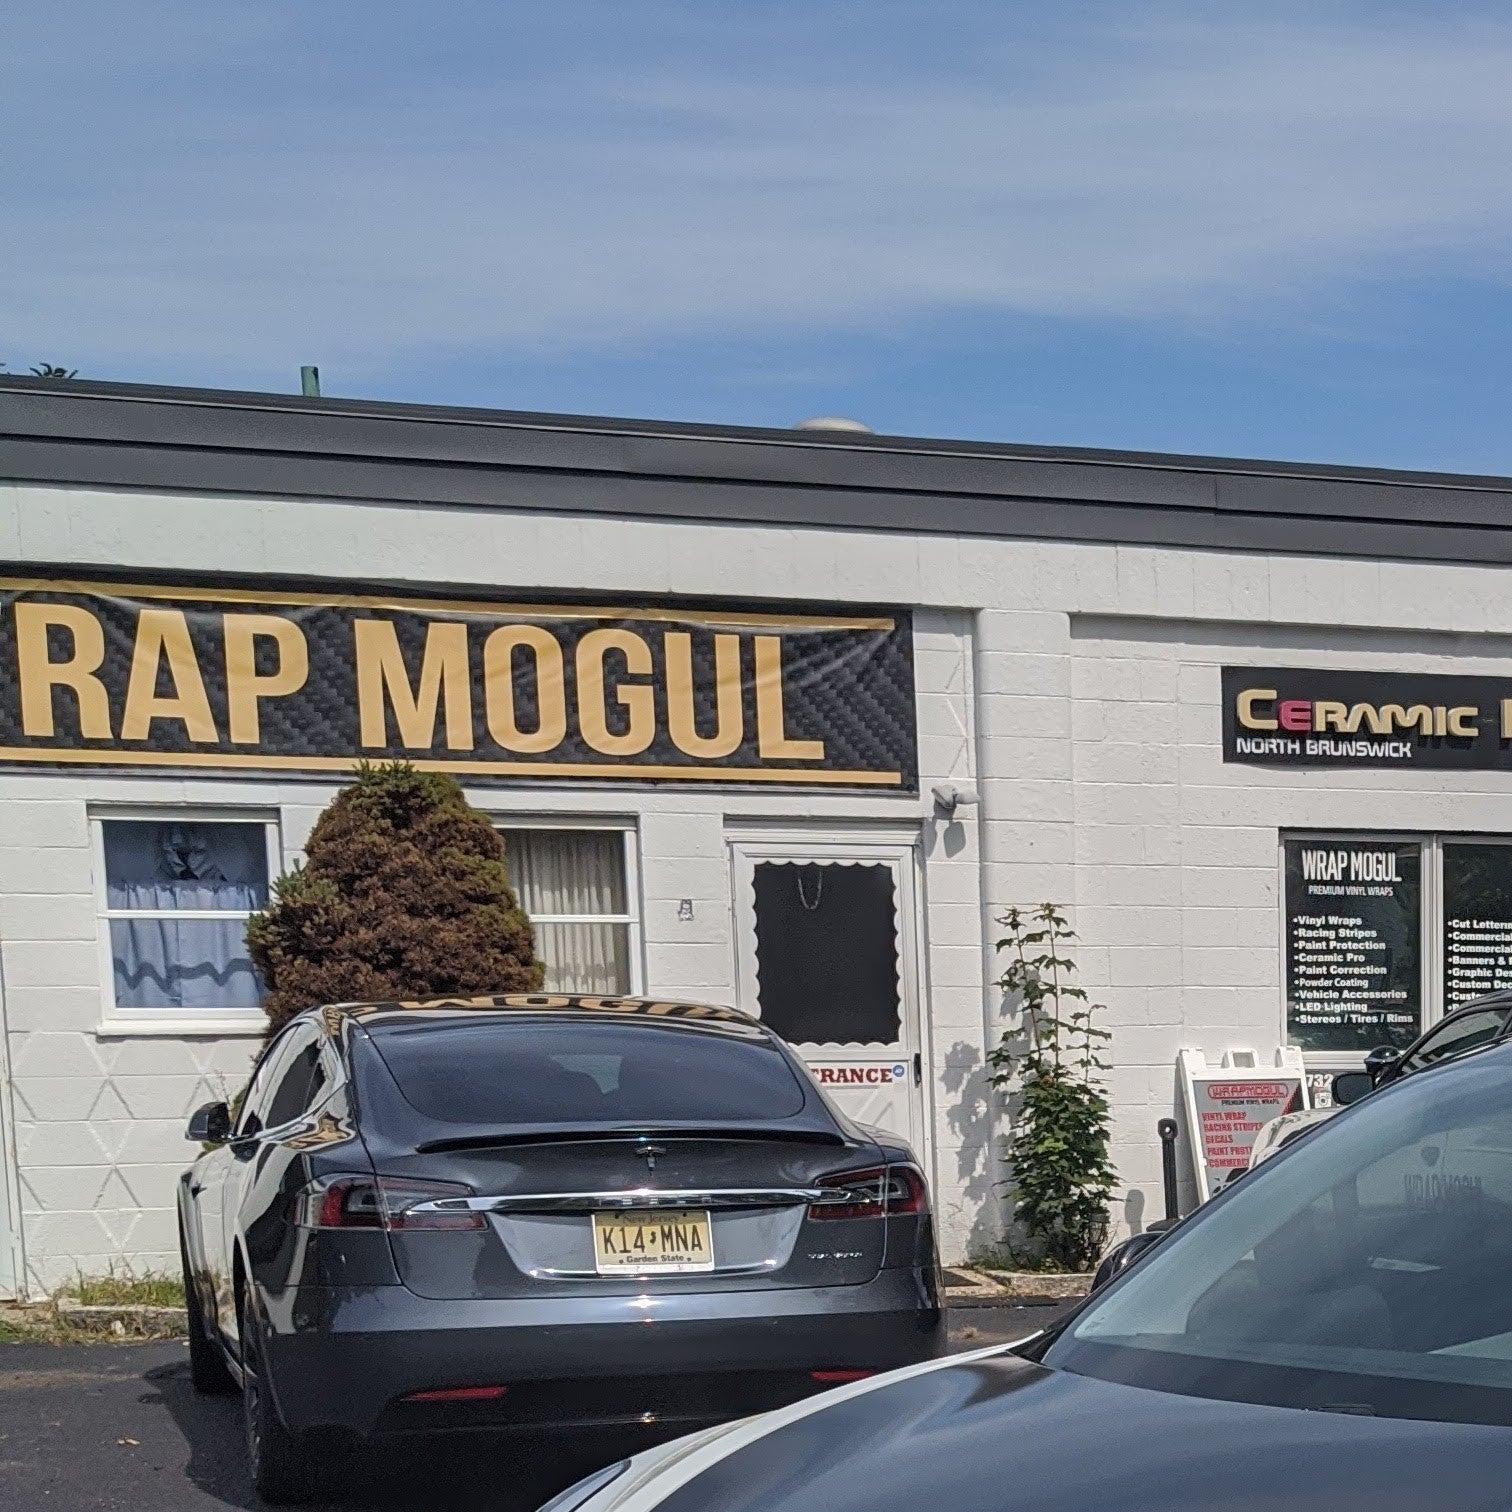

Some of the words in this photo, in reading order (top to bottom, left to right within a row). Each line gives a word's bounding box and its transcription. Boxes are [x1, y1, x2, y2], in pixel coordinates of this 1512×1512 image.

[15, 601, 309, 744] RAP
[353, 619, 825, 760] MOGUL
[1236, 688, 1478, 737] CERAMIC
[1236, 737, 1300, 755] NORTH
[1305, 738, 1411, 758] BRUNSWICK
[1302, 849, 1347, 881] WRAP
[1350, 851, 1402, 882] MOGUL
[1308, 885, 1344, 895] PREMIUM
[1346, 886, 1366, 896] VINYL
[1368, 886, 1393, 897] WRAPS
[1298, 916, 1325, 927] Vinyl
[1328, 916, 1362, 927] Wraps
[1452, 920, 1470, 929] Cut
[1298, 928, 1336, 939] Racing
[1338, 928, 1377, 939] Stripes
[1298, 941, 1327, 950] Paint
[1329, 941, 1386, 950] Protection
[1299, 953, 1344, 962] Ceramic
[1346, 953, 1365, 962] Pro
[1452, 956, 1495, 965] Banners
[1497, 957, 1507, 965] &
[1299, 965, 1328, 975] Paint
[1330, 965, 1387, 975] Correction
[1452, 968, 1493, 979] Graphic
[1300, 978, 1332, 987] Powder
[1334, 978, 1369, 988] Coating
[1452, 980, 1491, 989] Custom
[1299, 990, 1340, 999] Vehicle
[1342, 990, 1408, 999] Accessories
[1300, 1002, 1321, 1011] LED
[1324, 1002, 1368, 1013] Lighting
[1300, 1014, 1341, 1023] Stereos
[1350, 1014, 1379, 1023] Tires
[1386, 1013, 1414, 1023] Rims
[603, 1225, 646, 1255] K14
[660, 1224, 703, 1253] MNA
[626, 1255, 658, 1263] Garden
[661, 1254, 684, 1262] State
